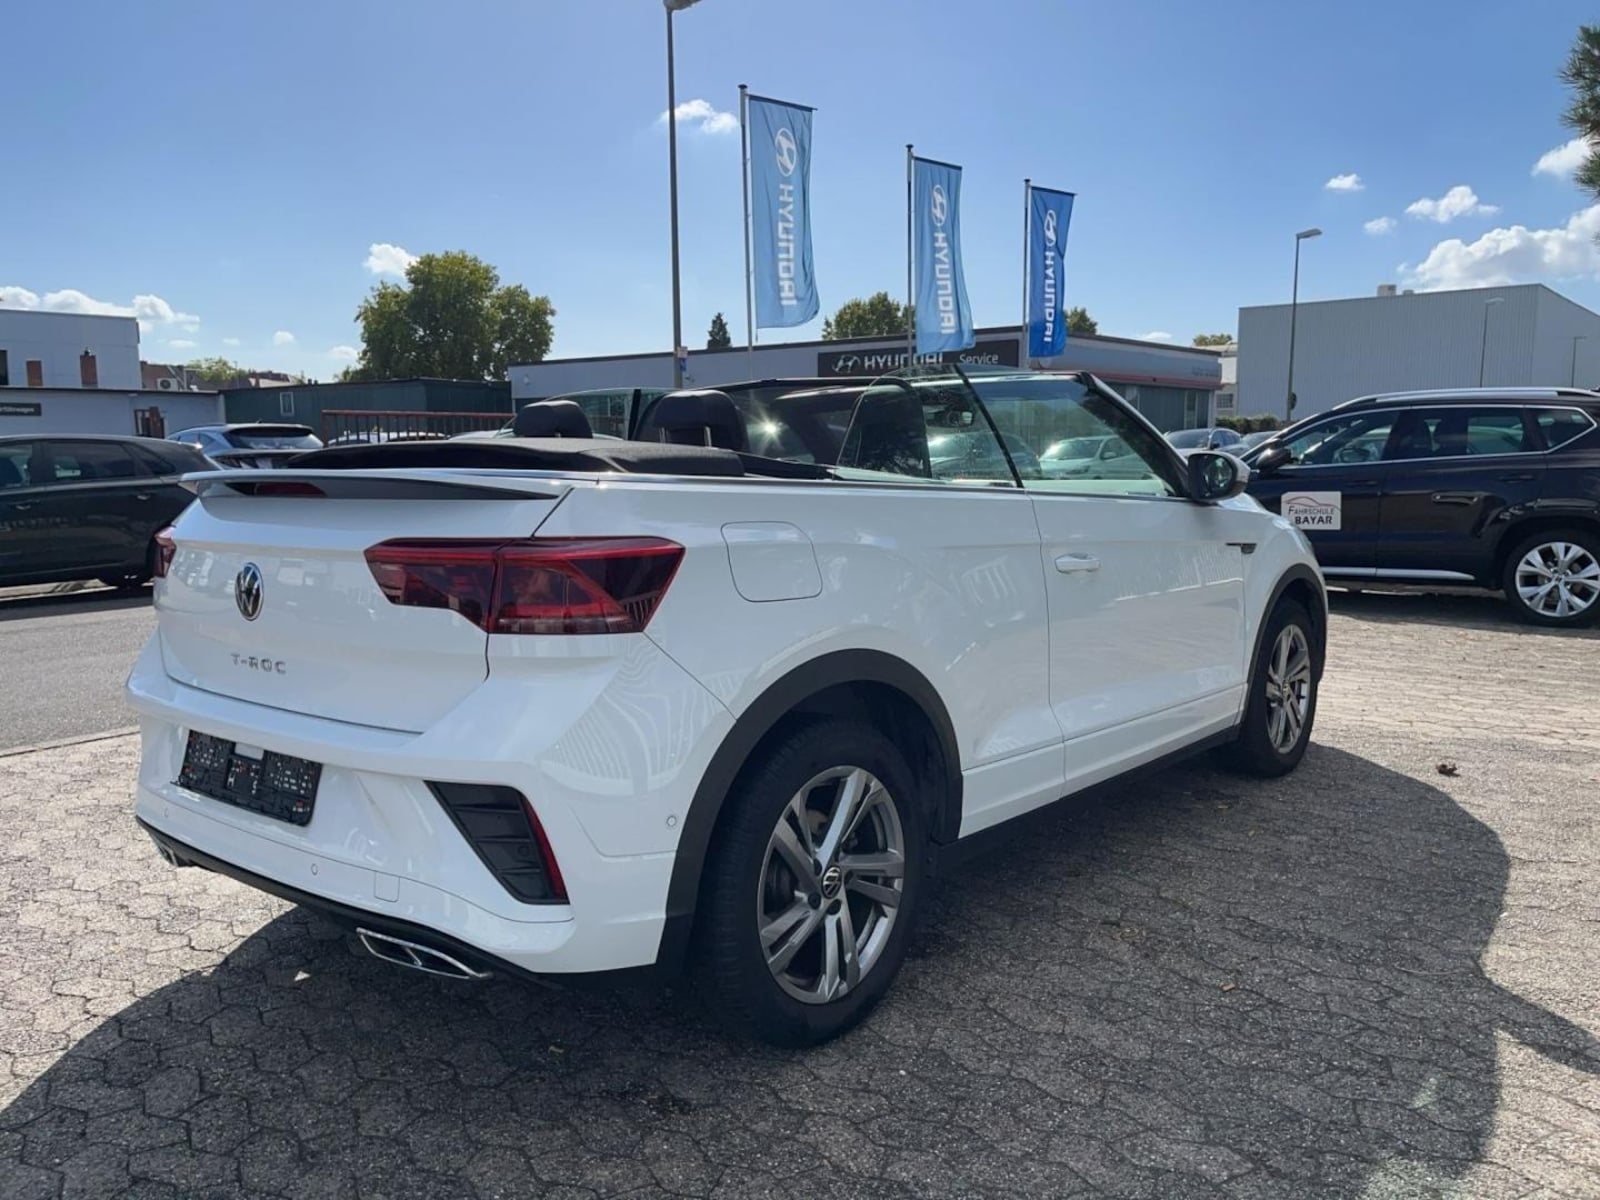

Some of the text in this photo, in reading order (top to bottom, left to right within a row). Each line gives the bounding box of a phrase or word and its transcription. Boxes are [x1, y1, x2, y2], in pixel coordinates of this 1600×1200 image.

[777, 183, 797, 305] HYUNDAI
[934, 232, 955, 334] HYUNDAI
[1043, 250, 1056, 342] HYUNDAI
[959, 352, 999, 365] Service
[1295, 515, 1333, 525] BAYAR
[230, 653, 287, 675] T-ROC
